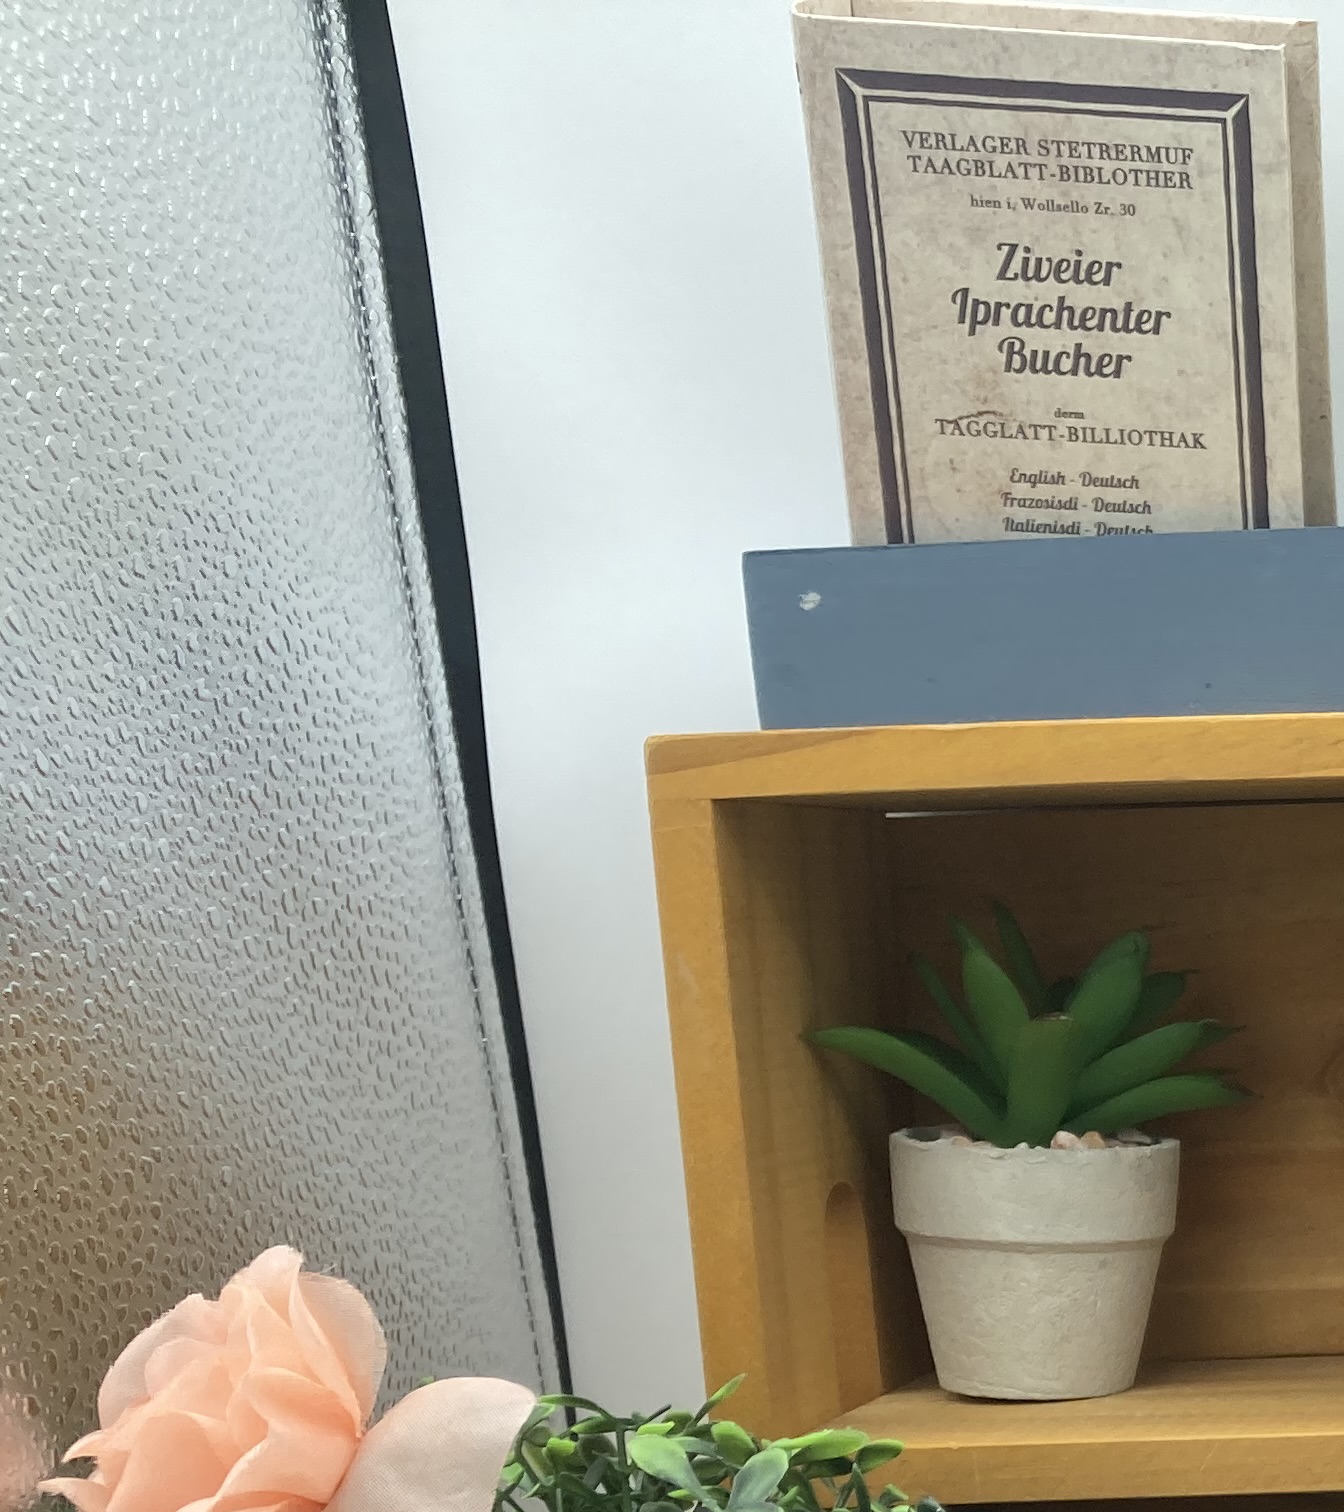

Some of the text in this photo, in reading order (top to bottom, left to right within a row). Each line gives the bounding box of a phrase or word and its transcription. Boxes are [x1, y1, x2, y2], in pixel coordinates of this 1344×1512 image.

[900, 130, 1195, 166] VERLAGER STETRERMUF
[906, 154, 1195, 190] TAAGBLATT-BIBLOTHER
[1118, 203, 1137, 217] 30
[951, 287, 1172, 337] Iprachenter
[997, 336, 1133, 380] Bucher
[934, 418, 1208, 450] TAGGLATT-BILLIOTHAK
[1009, 467, 1066, 489] English
[1079, 471, 1140, 489] Deutsch
[1091, 497, 1152, 515] Deutsch
